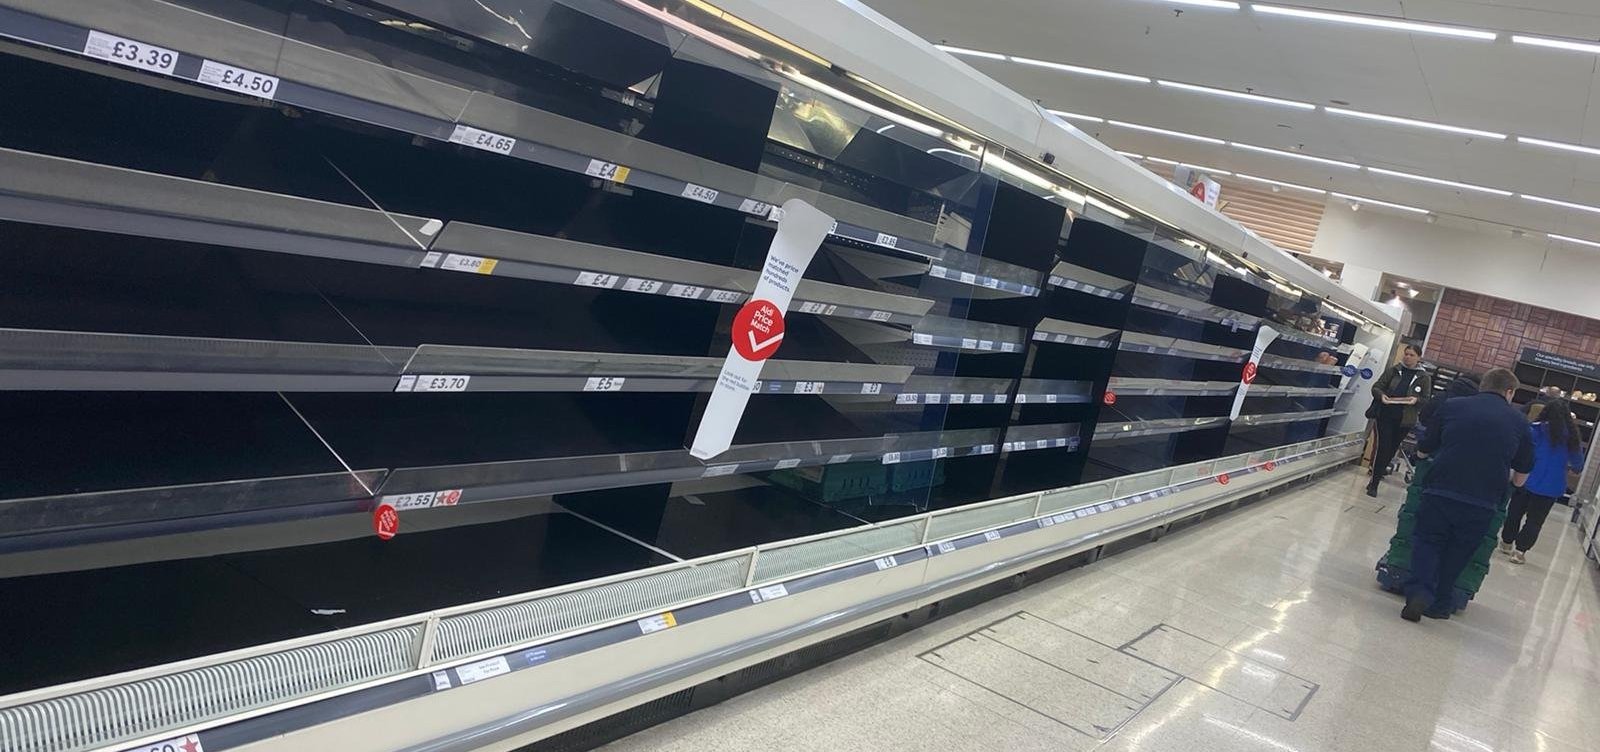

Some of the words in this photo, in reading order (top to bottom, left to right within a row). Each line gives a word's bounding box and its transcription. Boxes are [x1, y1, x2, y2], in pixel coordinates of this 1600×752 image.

[112, 41, 173, 69] £3.39
[222, 70, 274, 94] £4.50
[476, 134, 513, 151] £4.65
[599, 163, 618, 178] £4
[692, 186, 715, 201] £4.50
[752, 202, 765, 214] £3
[768, 262, 789, 277] matched
[785, 263, 799, 274] price
[592, 274, 608, 287] £4
[638, 281, 653, 292] £5
[681, 287, 696, 298] £3
[760, 305, 775, 317] Aldi
[753, 310, 774, 327] Price
[750, 319, 770, 335] Match
[429, 377, 465, 390] £3.70
[596, 377, 612, 390] £5
[395, 494, 430, 508] £2.55
